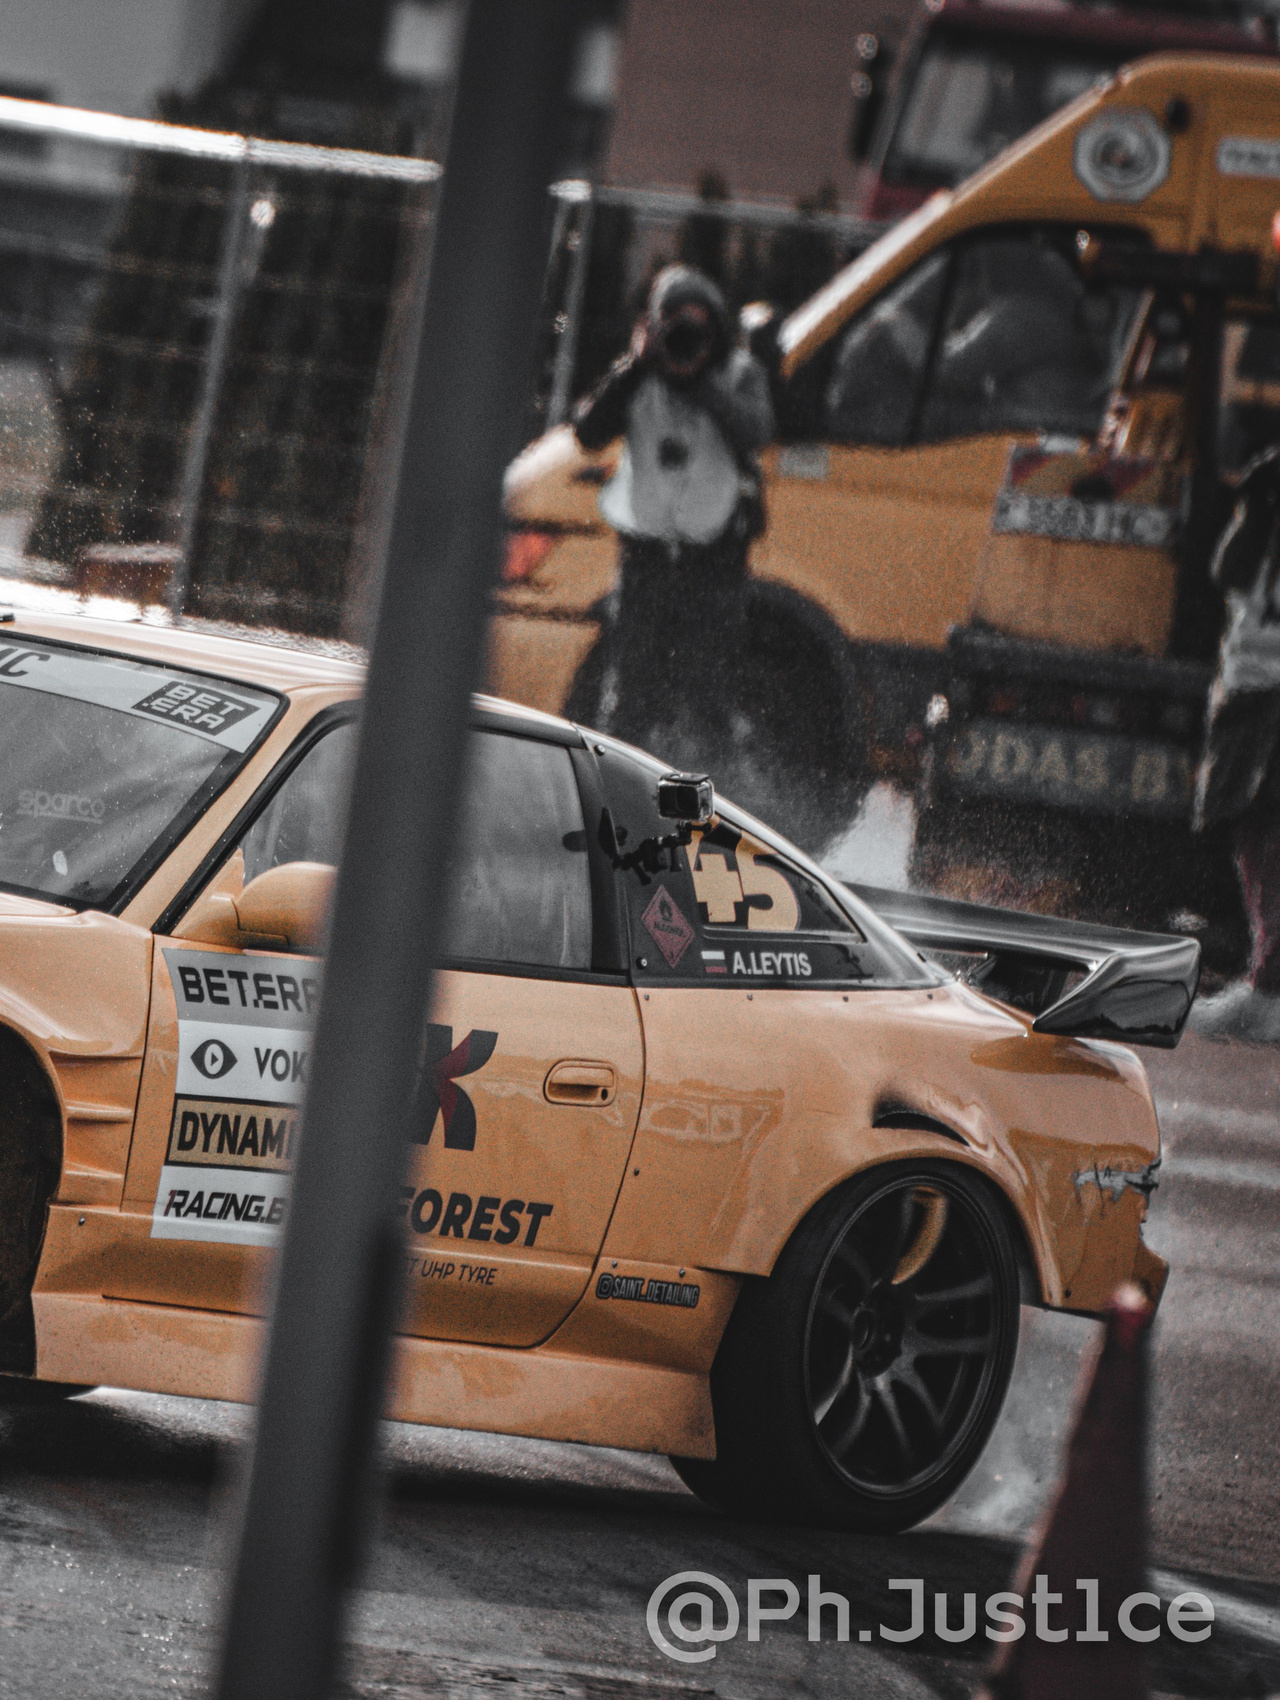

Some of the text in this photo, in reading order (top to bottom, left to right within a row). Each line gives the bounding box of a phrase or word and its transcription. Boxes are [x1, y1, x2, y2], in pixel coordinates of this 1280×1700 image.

[165, 684, 244, 715] BET
[685, 815, 800, 931] 45
[733, 951, 812, 976] A.LEYTIS
[421, 1260, 456, 1280] UHP
[459, 1264, 498, 1286] TYRE
